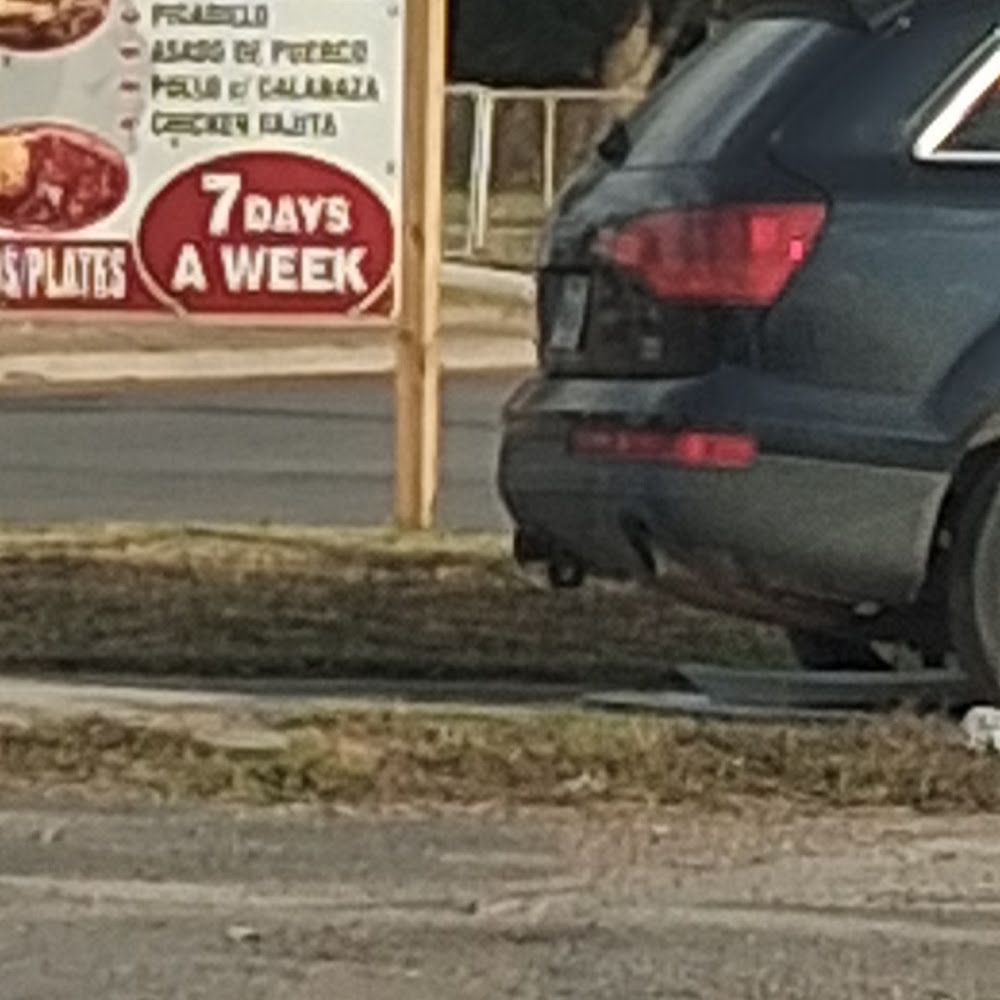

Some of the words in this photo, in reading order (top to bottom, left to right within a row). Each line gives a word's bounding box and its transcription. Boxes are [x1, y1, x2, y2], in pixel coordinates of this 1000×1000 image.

[152, 75, 221, 100] POLLO
[258, 75, 380, 100] CALABAZA
[201, 173, 242, 236] 7
[243, 193, 351, 235] DAYS
[171, 243, 207, 291] A
[220, 244, 369, 293] WEEK
